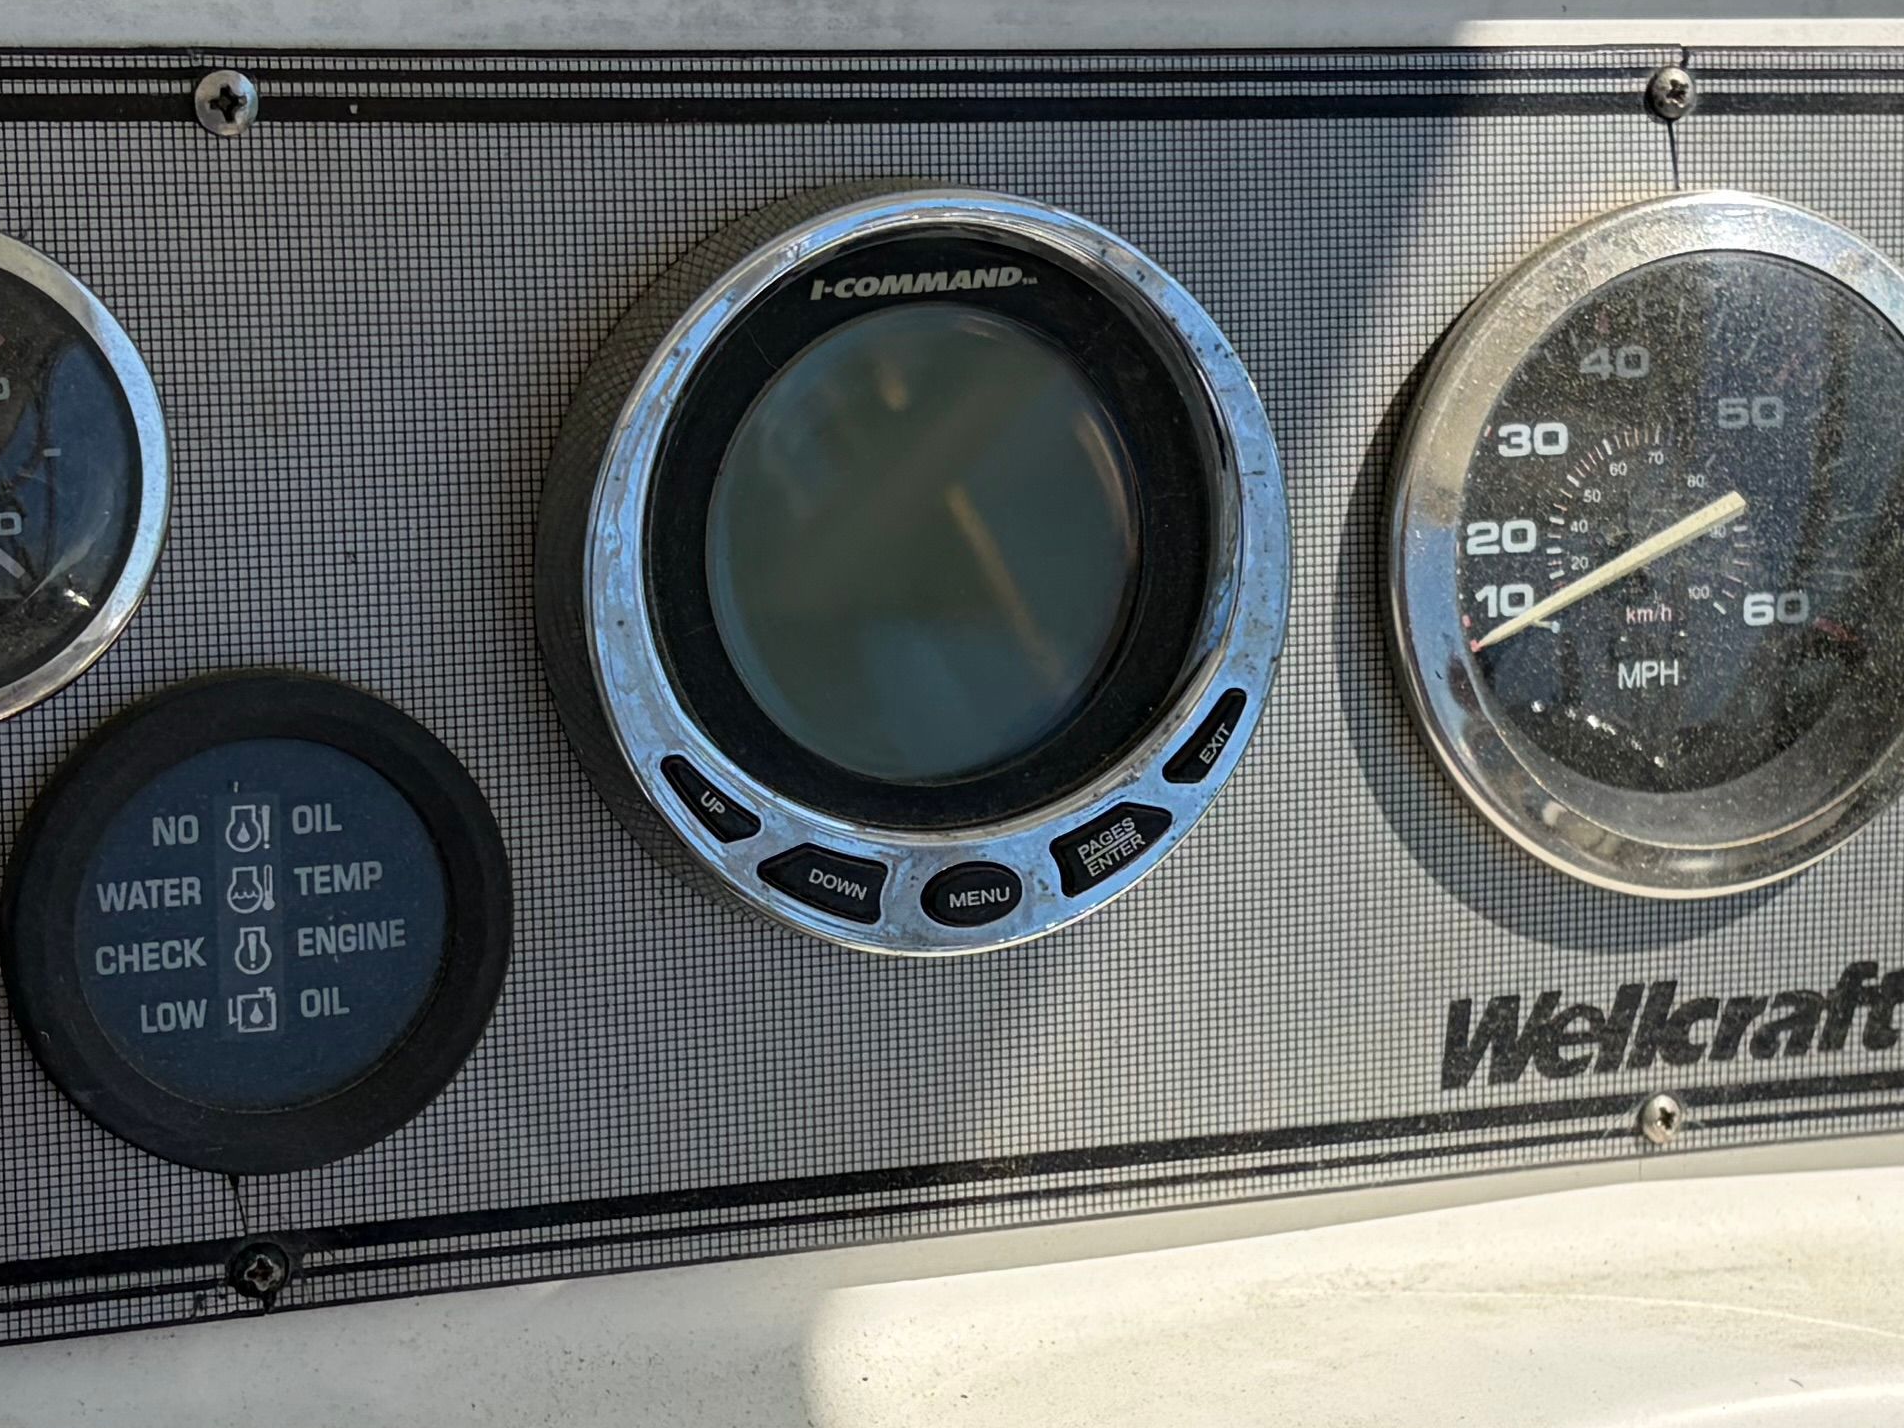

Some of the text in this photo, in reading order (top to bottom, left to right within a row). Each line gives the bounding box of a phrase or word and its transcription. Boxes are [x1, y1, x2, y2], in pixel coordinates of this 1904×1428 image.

[1580, 346, 1650, 379] 40
[1718, 398, 1786, 429] 50
[1498, 423, 1568, 456] 30
[1610, 464, 1627, 476] 60
[1648, 453, 1664, 465] 70
[1583, 491, 1601, 503] 50
[1687, 476, 1704, 487] 80
[1466, 520, 1536, 554] 20
[1570, 521, 1588, 533] 40
[1571, 558, 1588, 570] 20
[1475, 584, 1534, 618] 10
[1688, 587, 1709, 599] 100
[1743, 592, 1808, 626] 60
[1625, 605, 1672, 623] km/h
[1618, 659, 1679, 689] MPH
[1199, 724, 1231, 765] EXIT
[700, 792, 727, 816] UP
[152, 803, 342, 847] NO OIL
[1078, 816, 1135, 861] PAGES
[1086, 834, 1146, 878] ENTER
[96, 861, 383, 913] WATER TEMP
[809, 868, 868, 901] DOWN
[949, 886, 1010, 908] MENU
[95, 919, 406, 976] CHECK ENGINE
[141, 989, 350, 1033] LOW OIL
